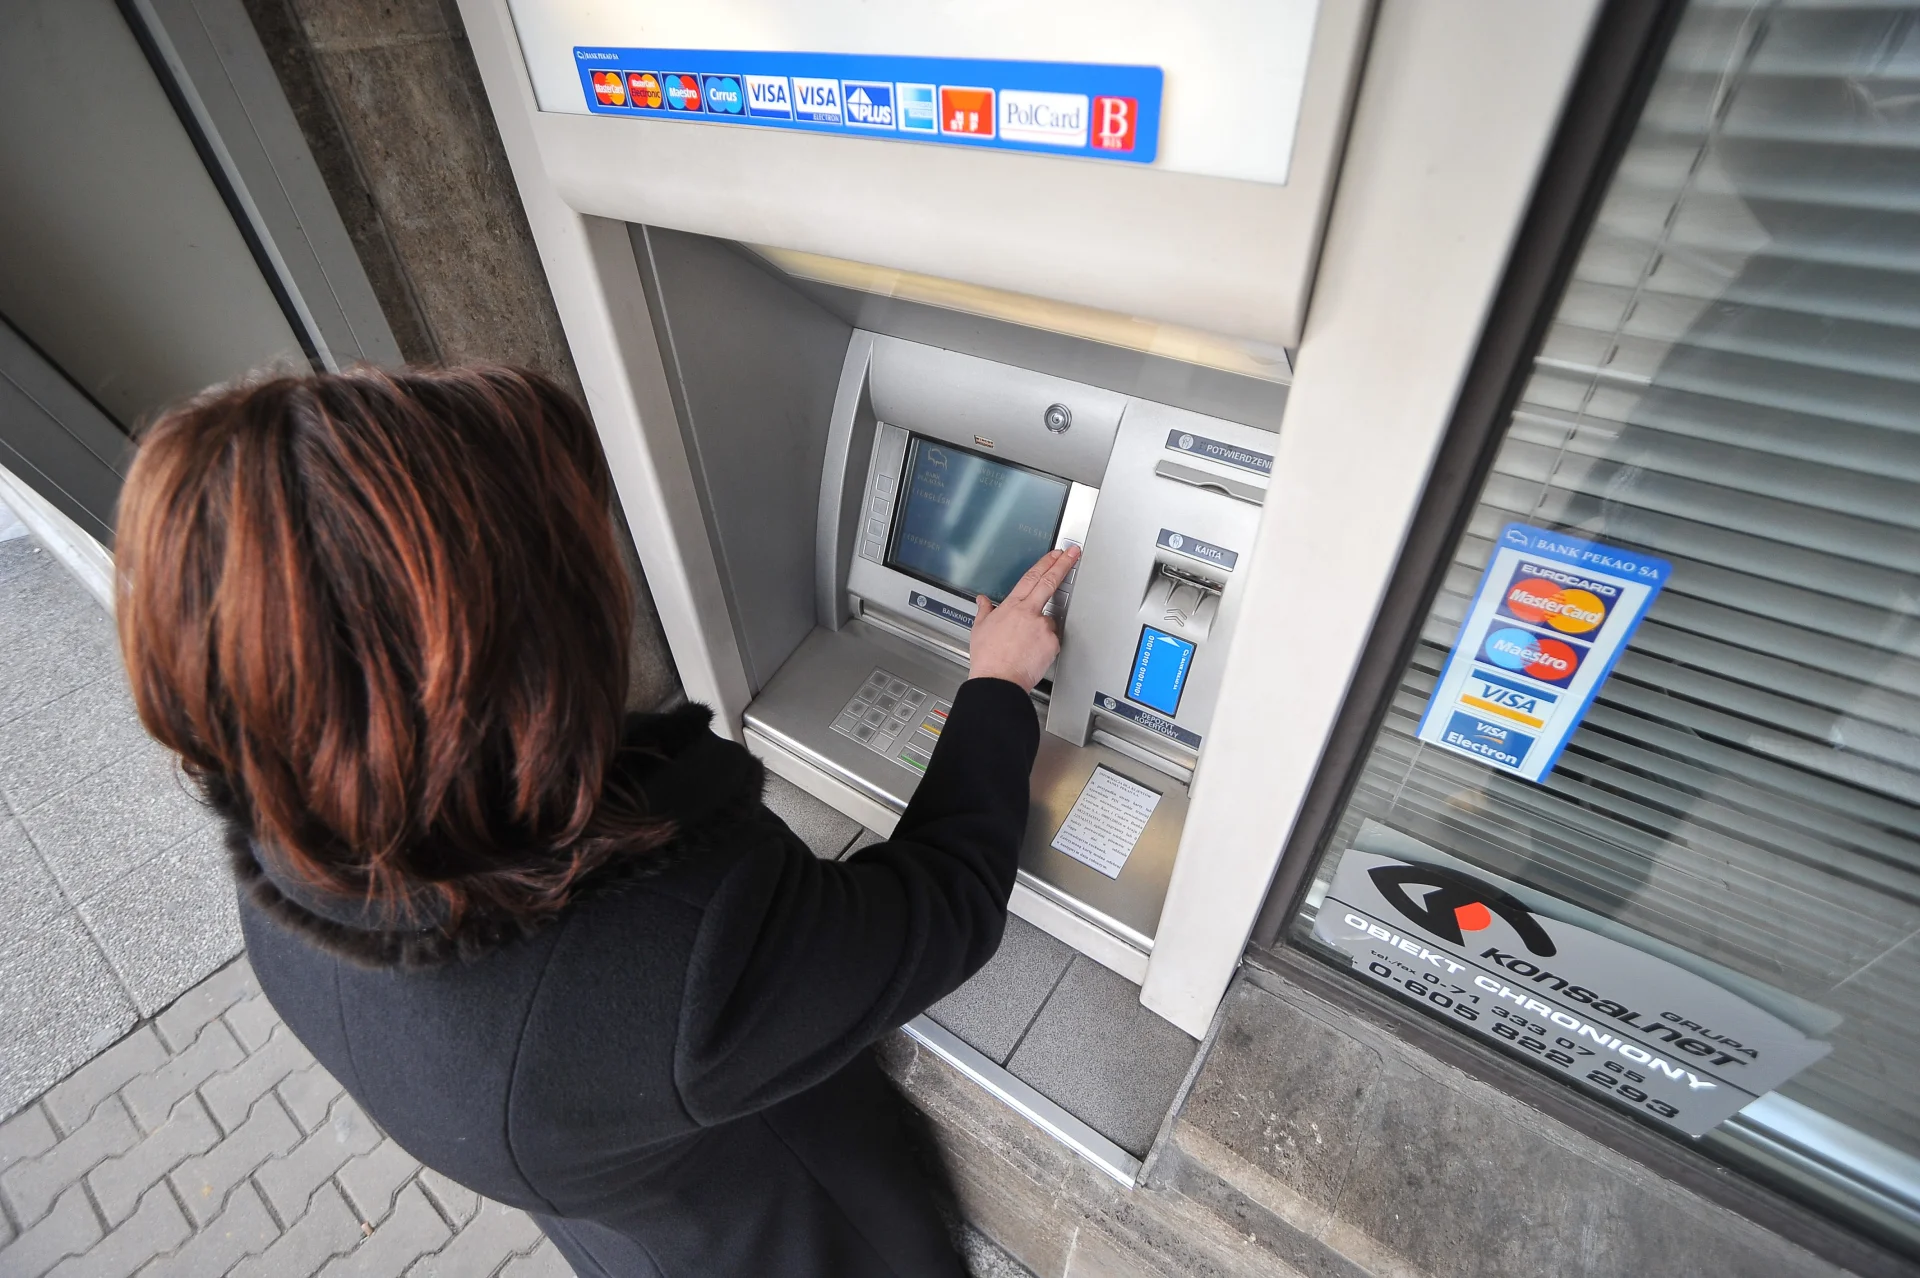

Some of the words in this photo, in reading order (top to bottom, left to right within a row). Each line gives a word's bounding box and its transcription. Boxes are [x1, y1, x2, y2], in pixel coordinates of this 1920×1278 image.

[595, 84, 623, 93] MasterCard
[632, 89, 660, 98] Electronic
[669, 88, 697, 98] Maestro
[710, 88, 737, 102] Cirrus
[750, 83, 787, 103] VISA
[797, 85, 837, 106] VISA
[813, 113, 840, 122] ELECTRON
[860, 104, 892, 123] PLUS
[1007, 103, 1080, 130] PolCard
[1099, 98, 1128, 137] B
[1194, 544, 1222, 560] KARTA
[1536, 540, 1579, 562] BANK
[1582, 550, 1636, 572] PEKAO
[1638, 566, 1659, 579] SA
[1521, 565, 1616, 597] EUROCARD
[1510, 589, 1602, 624] MasterCard
[1146, 635, 1155, 650] 0101
[1142, 652, 1150, 666] 0101
[1493, 640, 1568, 671] Maestro
[1138, 667, 1146, 682] 0101
[1134, 682, 1142, 696] 0101
[1481, 684, 1538, 714] VISA
[1134, 715, 1178, 738] KOPERTOWY
[1142, 712, 1174, 729] DEPOZYT
[1477, 722, 1508, 740] VISA
[1446, 732, 1518, 764] Electron
[1343, 912, 1466, 974] OBIEKT
[1474, 975, 1718, 1090] CHRONIONY
[1370, 950, 1416, 975] tel./fax
[1422, 972, 1480, 1004] 0-71
[1491, 1006, 1548, 1036] 333
[1555, 1037, 1596, 1056] 07
[1604, 1060, 1646, 1083] 65
[1368, 961, 1480, 1021] 0-605
[1492, 1022, 1574, 1068] 822
[1586, 1070, 1680, 1118] 293
[1659, 1012, 1759, 1058] GRUPA
